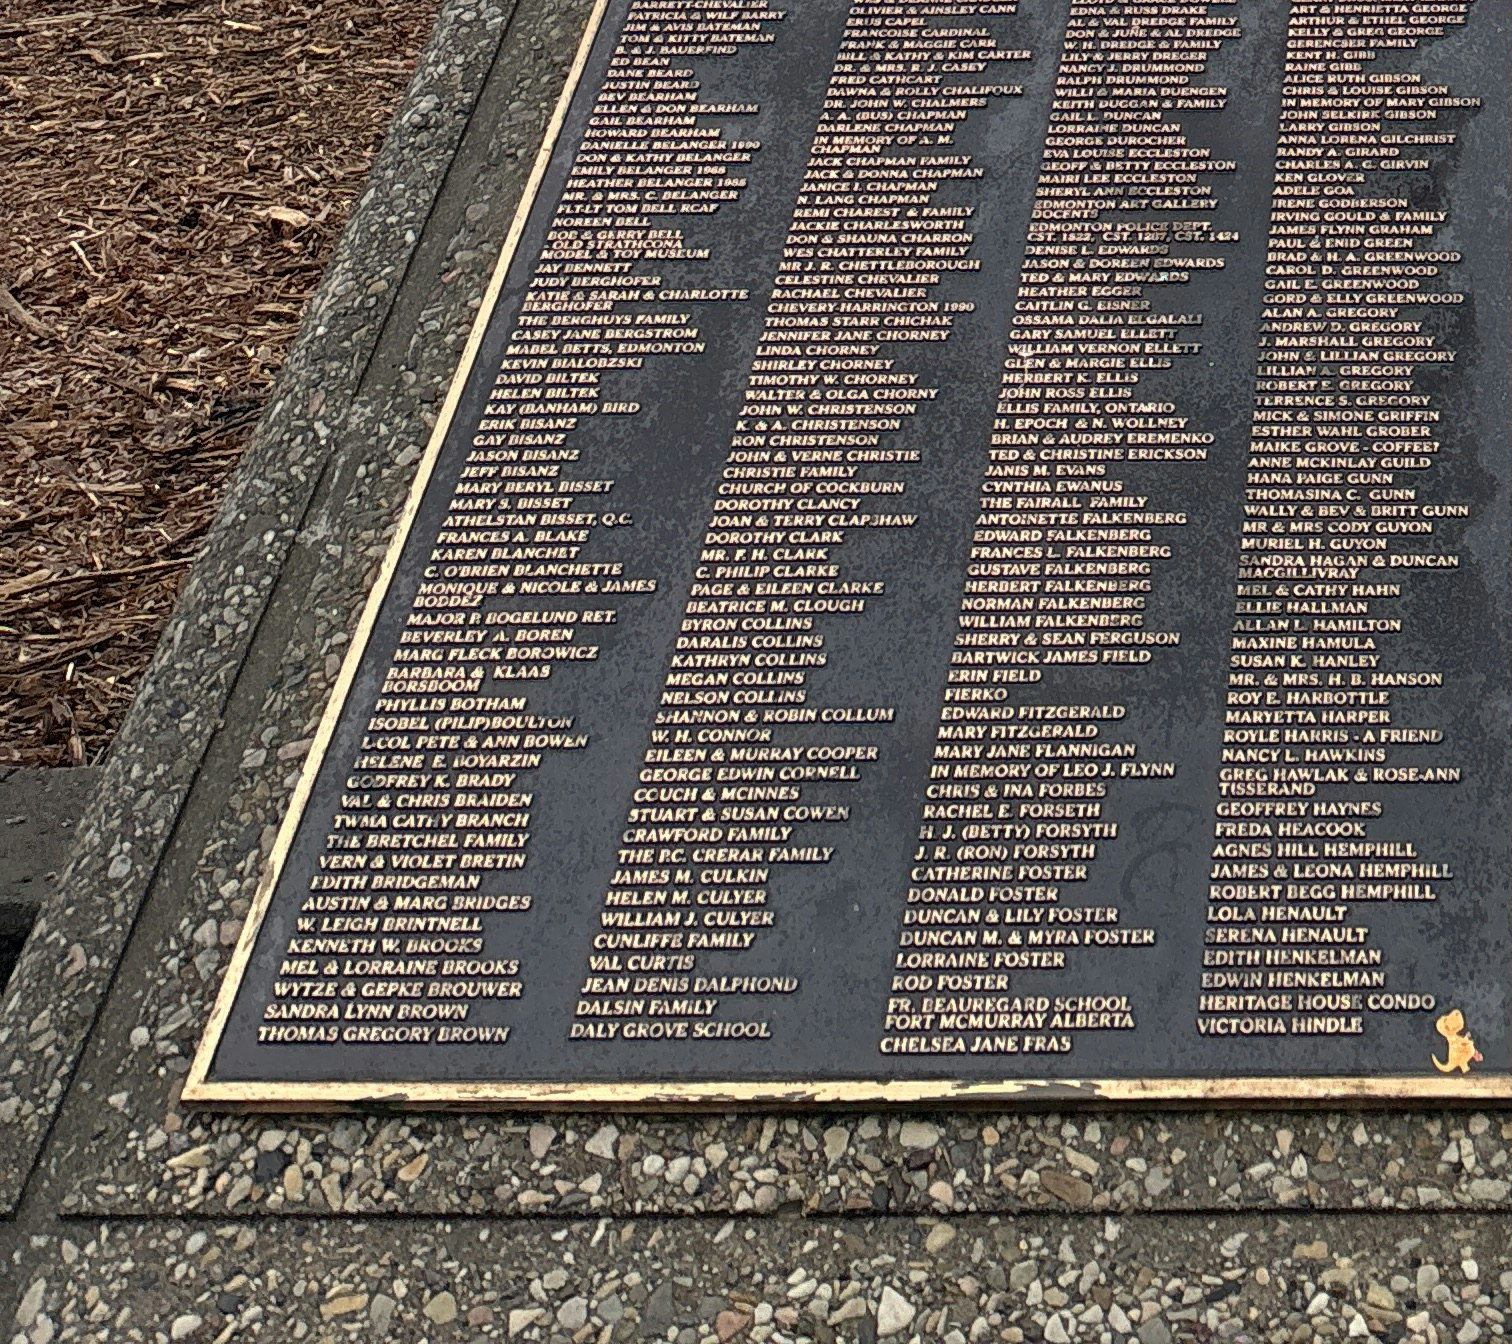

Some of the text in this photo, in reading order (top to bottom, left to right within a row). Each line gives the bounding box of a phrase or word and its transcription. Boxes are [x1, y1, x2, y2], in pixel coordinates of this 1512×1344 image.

[981, 480, 1123, 493] CYNTHIA EWANUS
[436, 530, 511, 544] FRANCES
[533, 529, 590, 543] BLAKE
[961, 596, 1145, 611] NORMAN FALKENBERG
[605, 889, 767, 906] HELEN M. CULYER
[1207, 905, 1348, 922] LOLA HENAULT
[286, 937, 483, 954] KENNETH W. BROOKS
[593, 932, 755, 949] CUNLIFFE FAMILY
[895, 951, 1065, 969] LORRAINE FOSTER
[1203, 949, 1382, 966] EDITH HENKELMAN
[279, 959, 520, 975] MEL & LORRAINE BROOKS
[580, 976, 798, 993] JEAN DENIS DALPHOND
[891, 974, 1009, 991] ROD FOSTER
[1199, 994, 1293, 1011] HERITAGE
[1367, 993, 1436, 1010] CONDO
[884, 1012, 1135, 1030] FORT MCMURRAY ALBERTA
[1197, 1016, 1363, 1034] VICTORIA HINDLE
[258, 1025, 510, 1042] THOMAS GREGORY BROWN
[569, 1022, 771, 1038] DALY GROVE SCHOOL
[880, 1035, 1071, 1053] CHELSEA JANE FRAS
